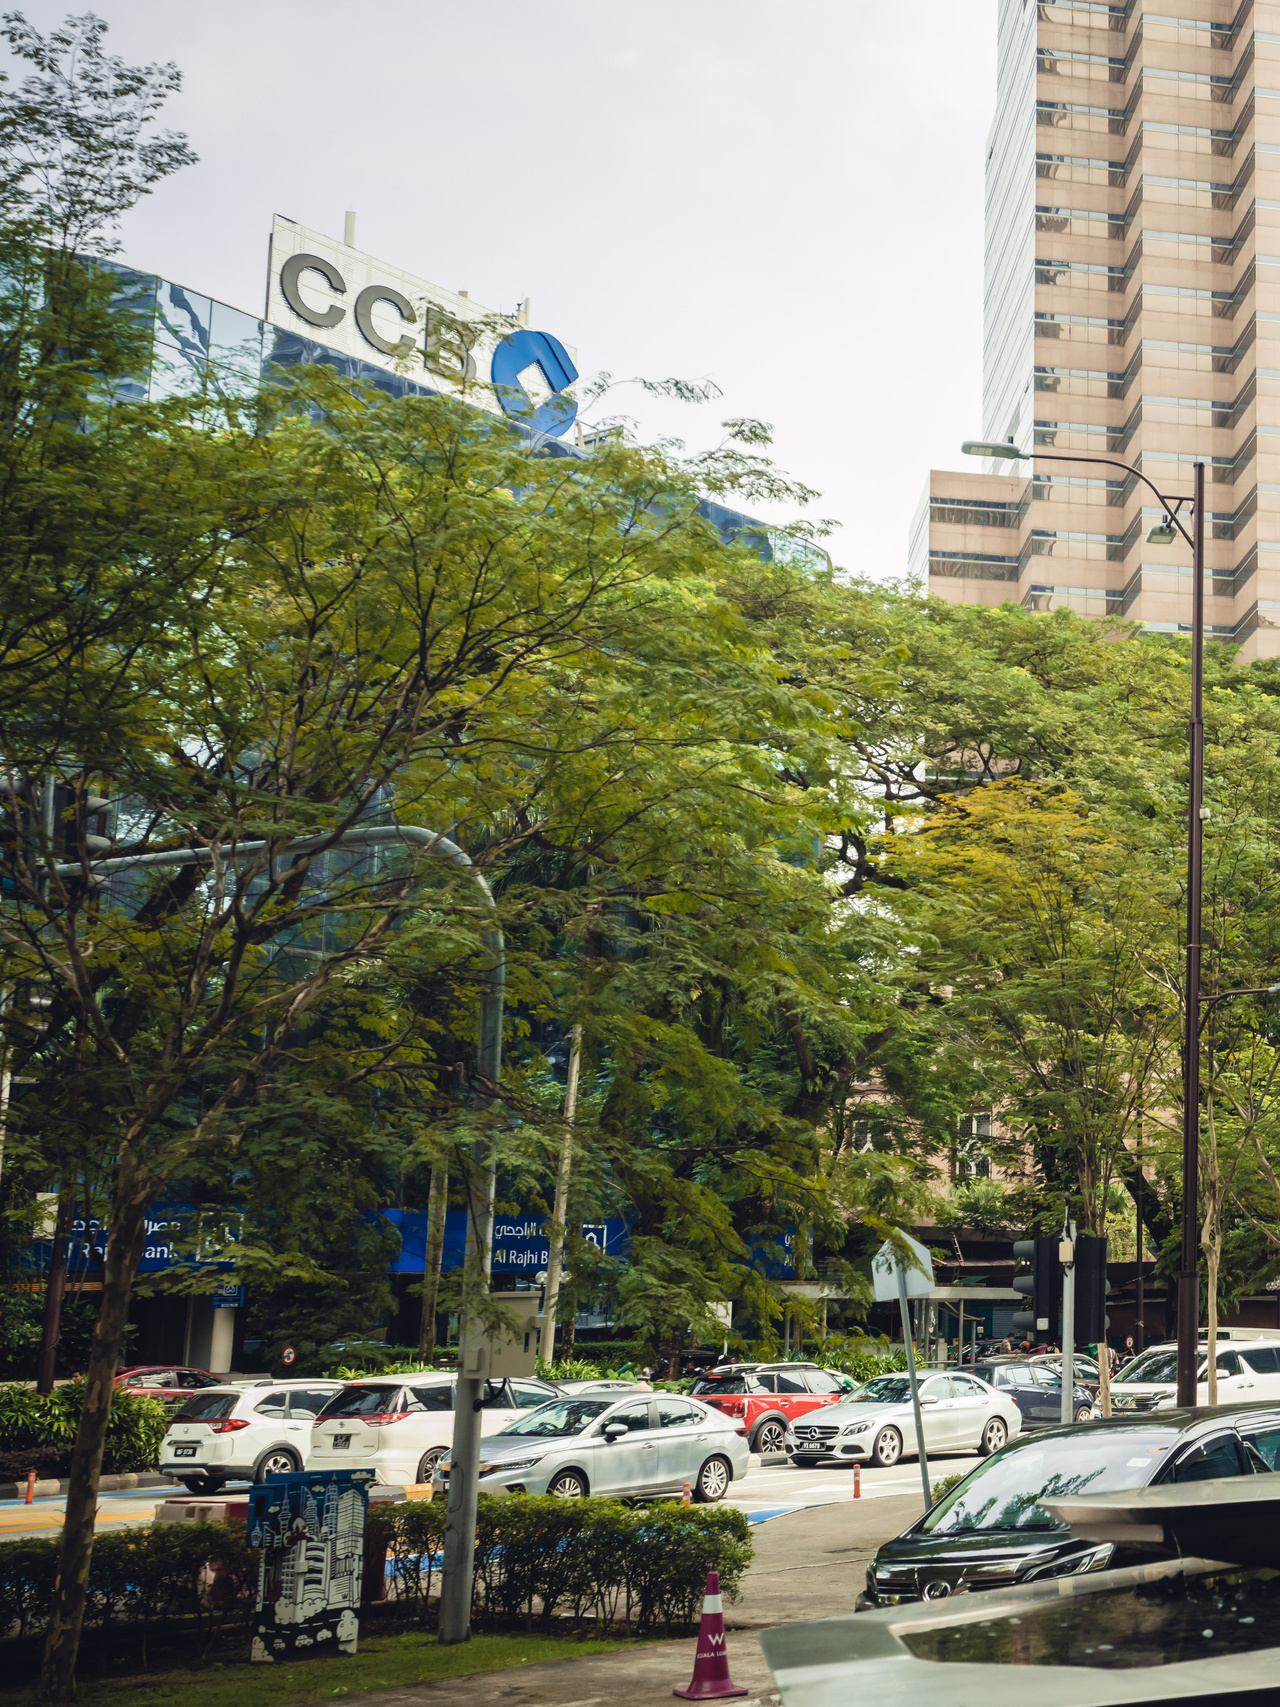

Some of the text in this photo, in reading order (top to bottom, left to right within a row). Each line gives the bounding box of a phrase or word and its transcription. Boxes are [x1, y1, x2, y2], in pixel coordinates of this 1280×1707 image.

[280, 253, 477, 382] CCB
[509, 1250, 538, 1267] Rajhi
[707, 1632, 724, 1646] W
